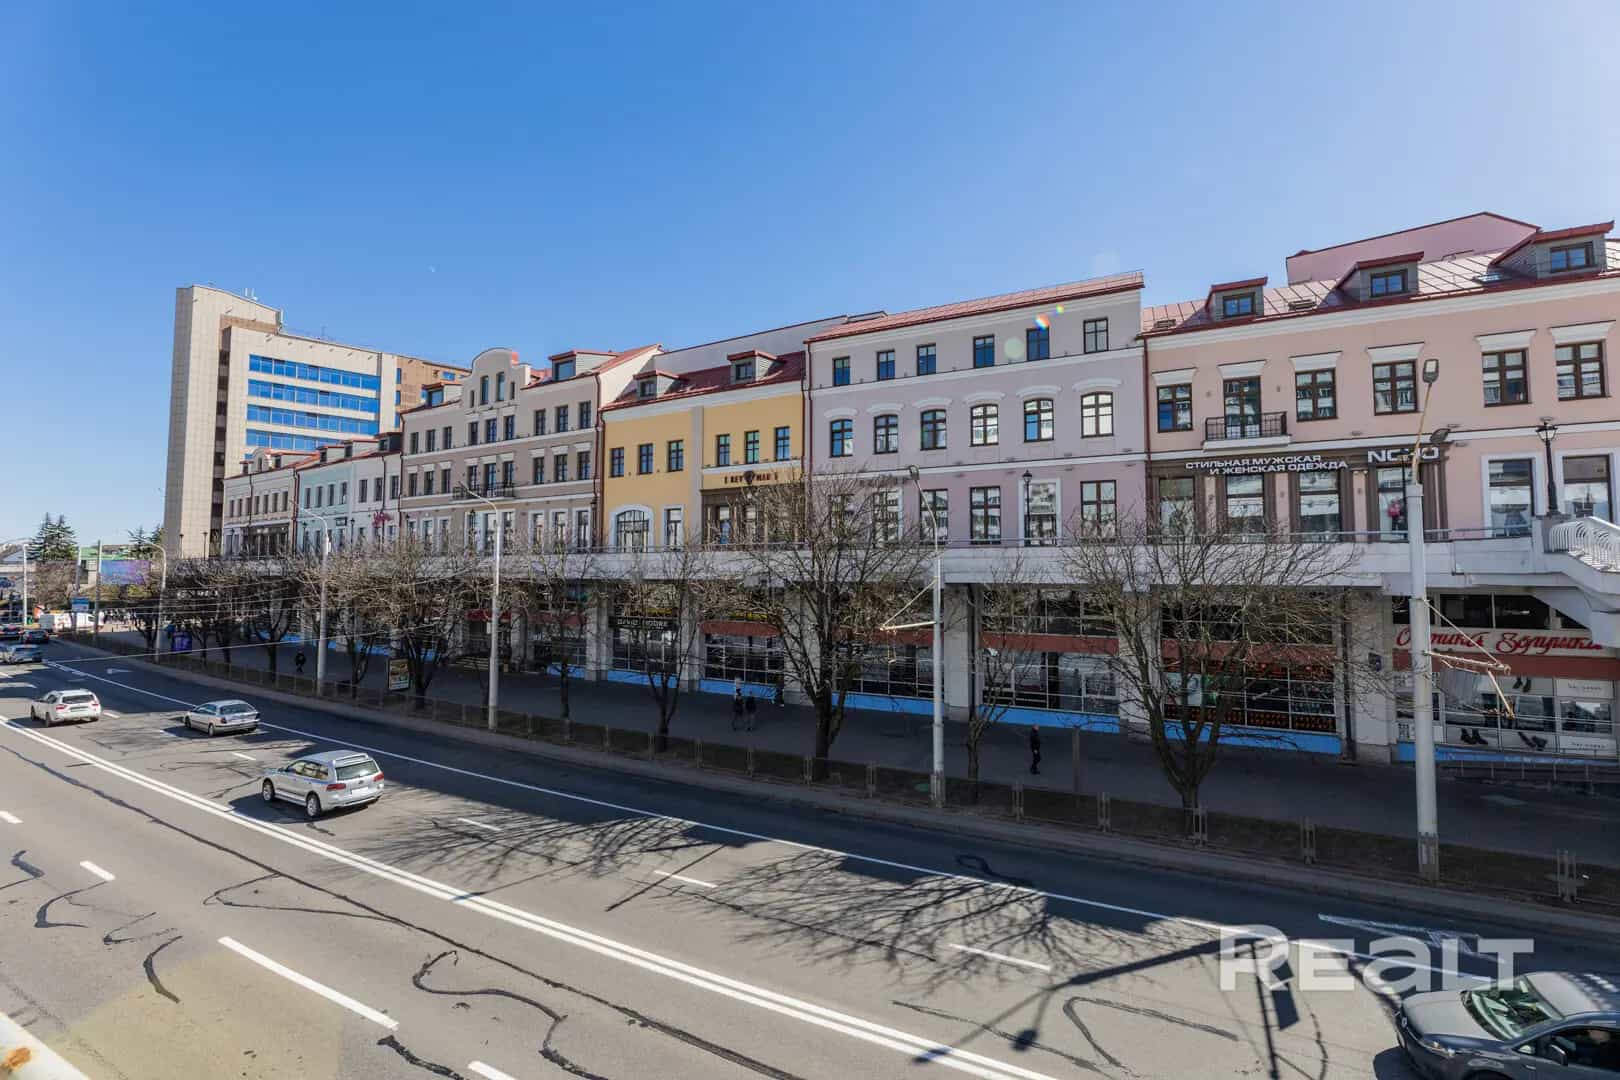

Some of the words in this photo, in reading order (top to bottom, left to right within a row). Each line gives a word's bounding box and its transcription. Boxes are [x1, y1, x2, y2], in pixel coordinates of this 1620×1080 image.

[1185, 459, 1250, 470] СТИЛЬНАЯ
[1252, 455, 1322, 466] МУЖСКАЯ
[1222, 464, 1286, 475] ЖЕНСКАЯ
[1287, 460, 1349, 472] ОДЕЖДА
